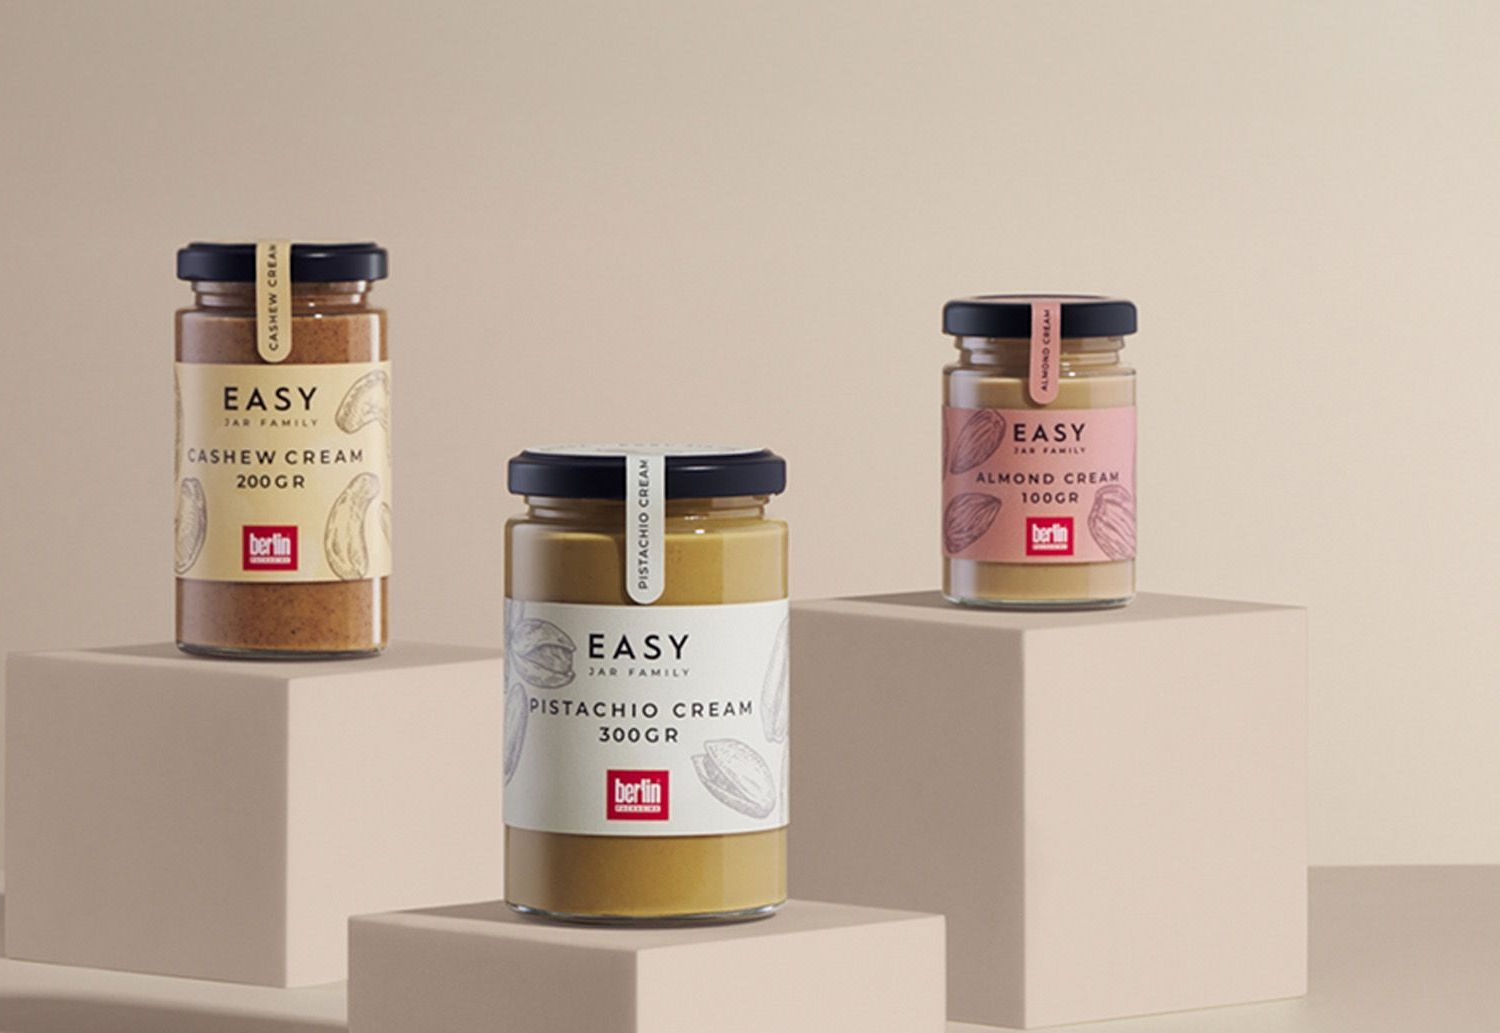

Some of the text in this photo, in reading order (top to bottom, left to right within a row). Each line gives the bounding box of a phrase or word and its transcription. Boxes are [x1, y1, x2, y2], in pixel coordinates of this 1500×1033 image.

[267, 292, 280, 352] CASHEW
[1040, 309, 1052, 392] ALMOND CREAM
[224, 386, 318, 412] EASY
[224, 417, 318, 428] JAR FAMILY
[1013, 422, 1086, 443] EASY
[188, 448, 363, 466] CASHEW CREAM
[1013, 446, 1086, 455] JAR FAMILY
[236, 473, 306, 490] 200GR
[975, 471, 1120, 486] ALMOND CREAM
[1021, 491, 1079, 505] 100GR
[1032, 524, 1068, 542] berlin
[250, 533, 291, 556] berlin
[637, 511, 650, 590] PISTACHIO
[588, 633, 689, 661] EASY
[588, 666, 690, 678] JAR FAMILY
[530, 697, 753, 719] PISTACHIO CREAM
[598, 726, 679, 744] 300GR
[615, 778, 661, 803] berlin
